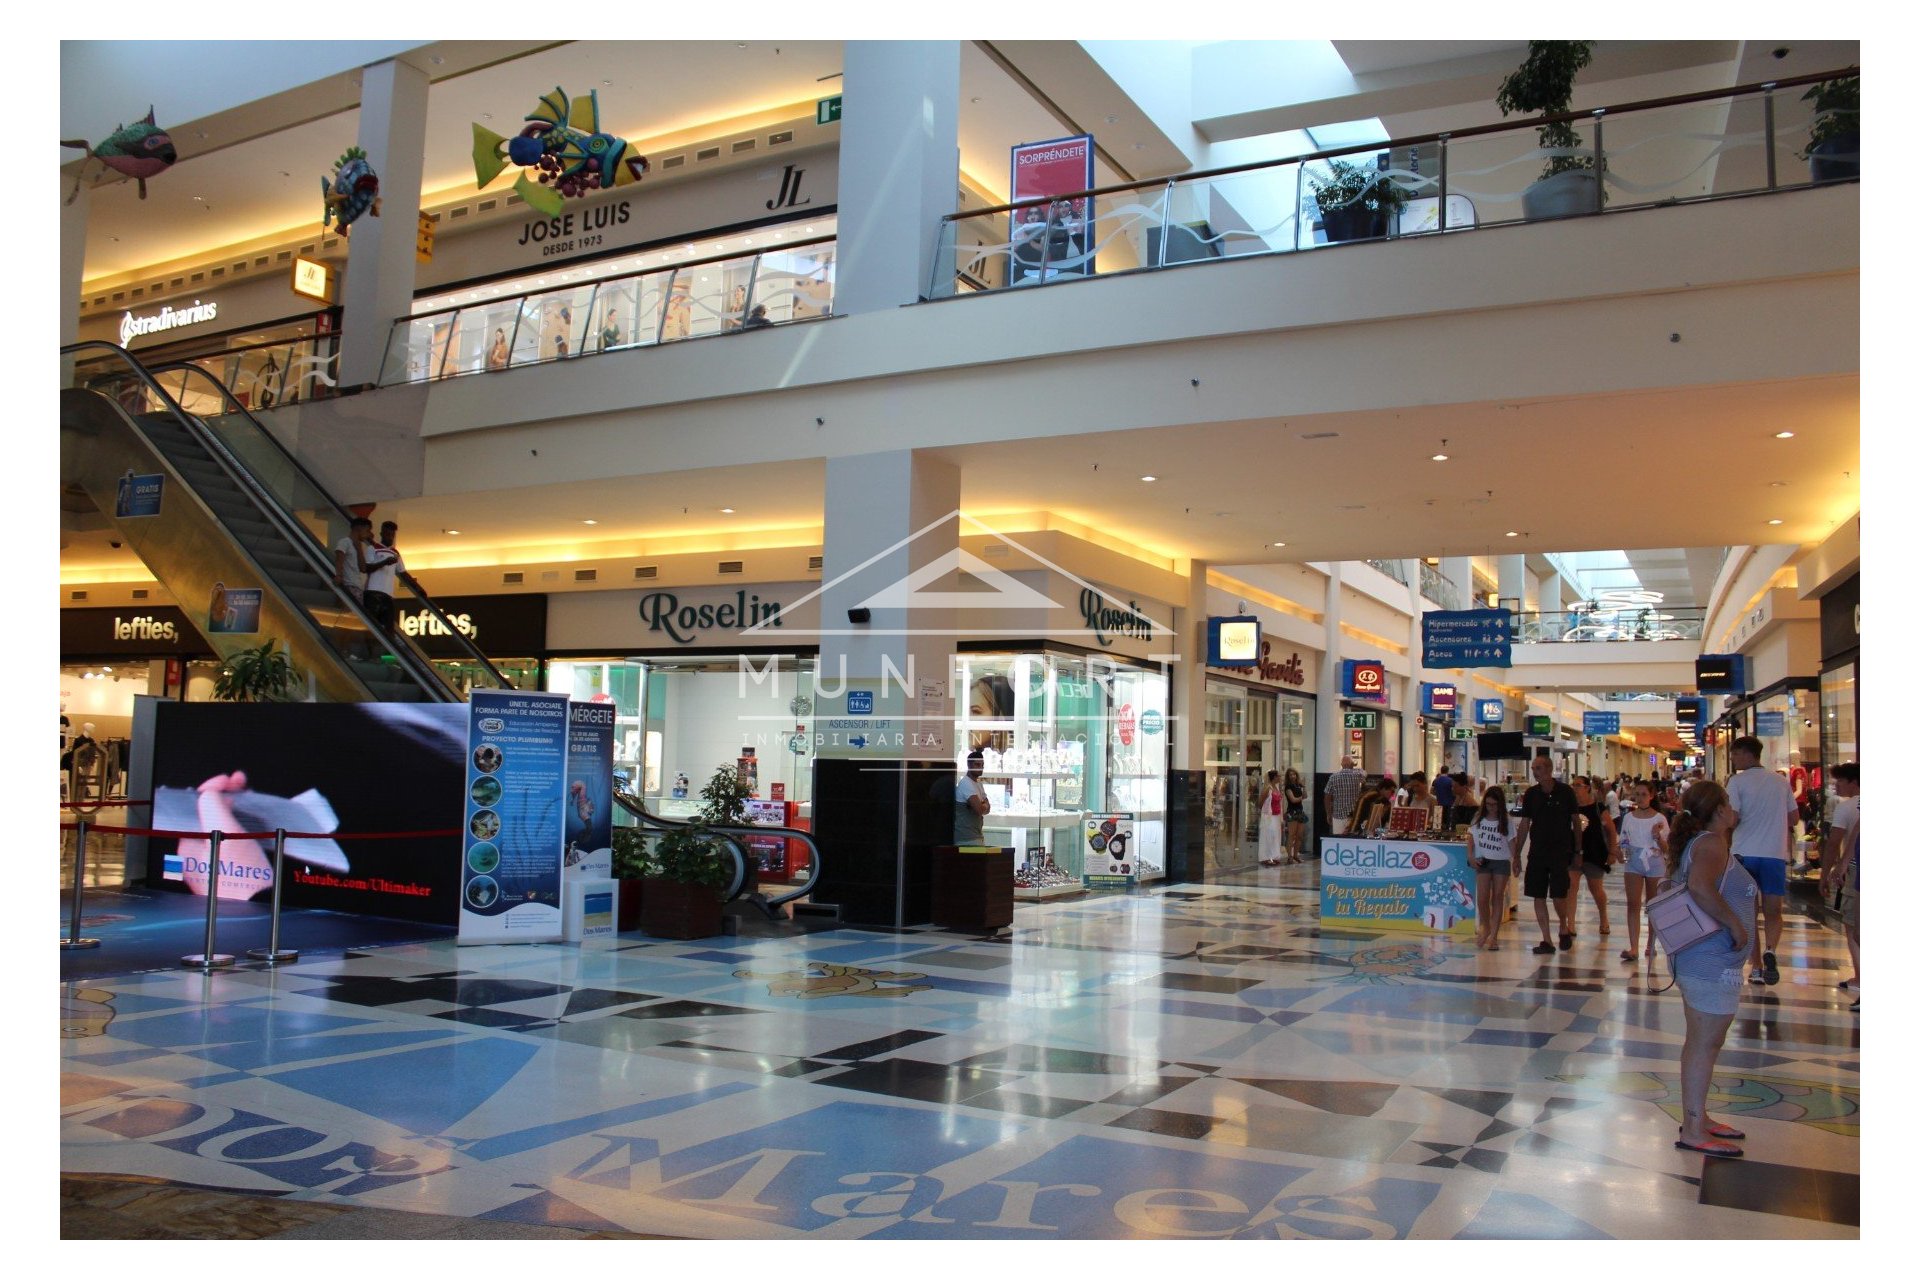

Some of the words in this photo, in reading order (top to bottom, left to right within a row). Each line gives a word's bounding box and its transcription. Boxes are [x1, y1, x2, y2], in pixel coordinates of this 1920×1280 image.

[1019, 145, 1085, 166] SORPRÉNDETE
[766, 163, 811, 211] JL
[518, 213, 574, 246] JOSE
[583, 201, 631, 231] LUIS
[542, 239, 575, 257] DESDE
[577, 234, 604, 250] 1973
[638, 590, 784, 644] Roselin
[1428, 619, 1479, 630] Hipermercado
[1428, 634, 1473, 644] Ascensores
[1428, 649, 1453, 658] Aseos
[1433, 687, 1454, 696] GAME
[475, 706, 500, 714] FORMA
[500, 708, 518, 716] PARTE
[828, 719, 869, 729] ASCENSOR
[875, 719, 891, 729] LIFT
[570, 744, 597, 753] GRATIS
[218, 860, 272, 880] Mares
[1344, 867, 1377, 877] STORE
[1326, 882, 1417, 900] Personaliza
[1335, 900, 1351, 915] tu
[1354, 899, 1410, 920] Regalo
[560, 1133, 1398, 1240] Mares
